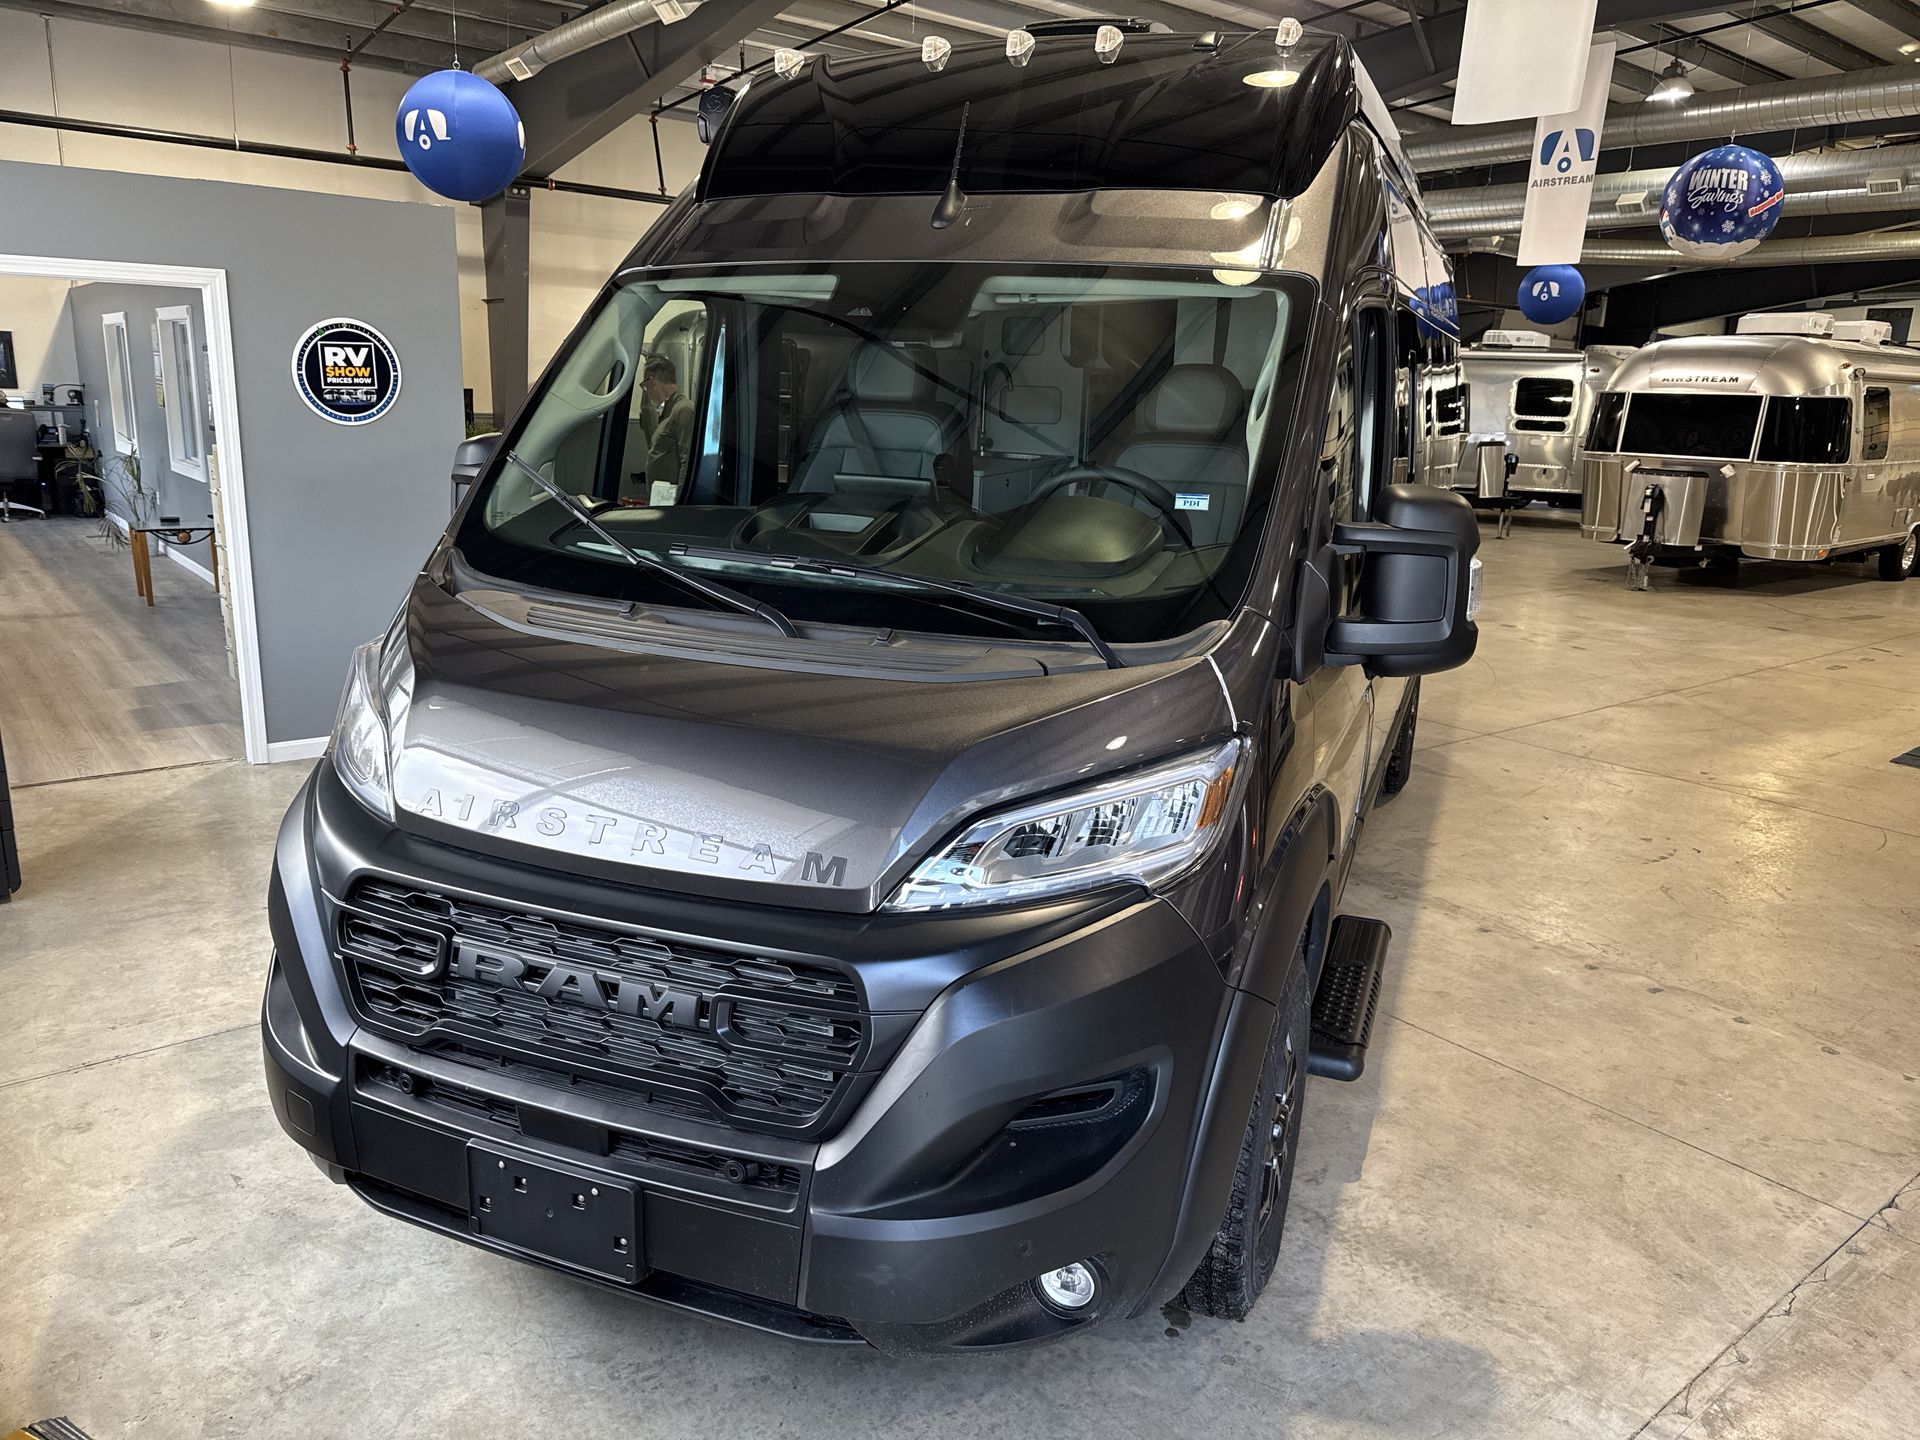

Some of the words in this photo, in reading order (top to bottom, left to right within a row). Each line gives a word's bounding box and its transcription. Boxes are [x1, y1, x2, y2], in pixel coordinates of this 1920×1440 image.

[1530, 174, 1594, 188] AIRSTREAM
[1688, 168, 1749, 191] WINTER
[1687, 185, 1745, 212] Savings
[323, 346, 370, 367] RV
[1662, 375, 1740, 384] AIRSTREAM
[416, 787, 848, 887] AIRSTREAM
[454, 939, 704, 1030] RAM
